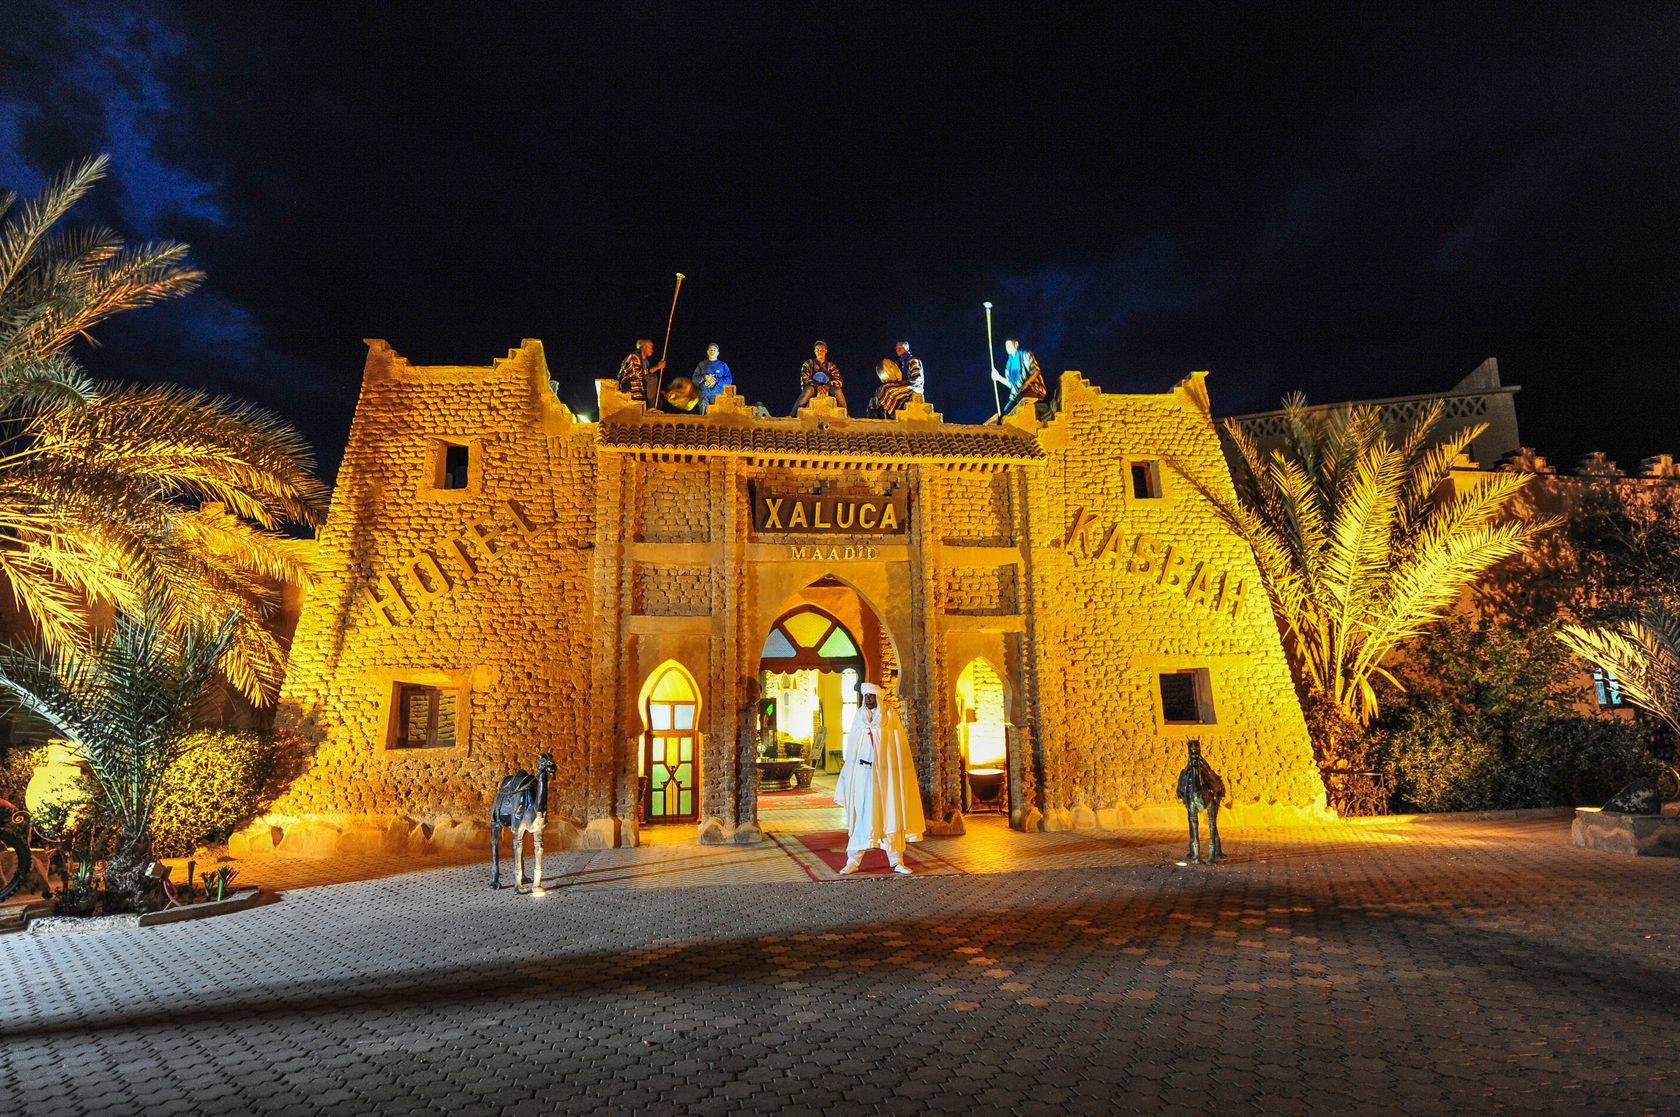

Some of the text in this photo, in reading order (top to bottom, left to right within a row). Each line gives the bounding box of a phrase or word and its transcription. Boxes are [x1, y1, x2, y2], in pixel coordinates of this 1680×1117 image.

[765, 498, 898, 529] XALUCA
[364, 499, 556, 629] HOTEL
[791, 545, 879, 561] MAADID
[1064, 506, 1249, 620] KASBAH
